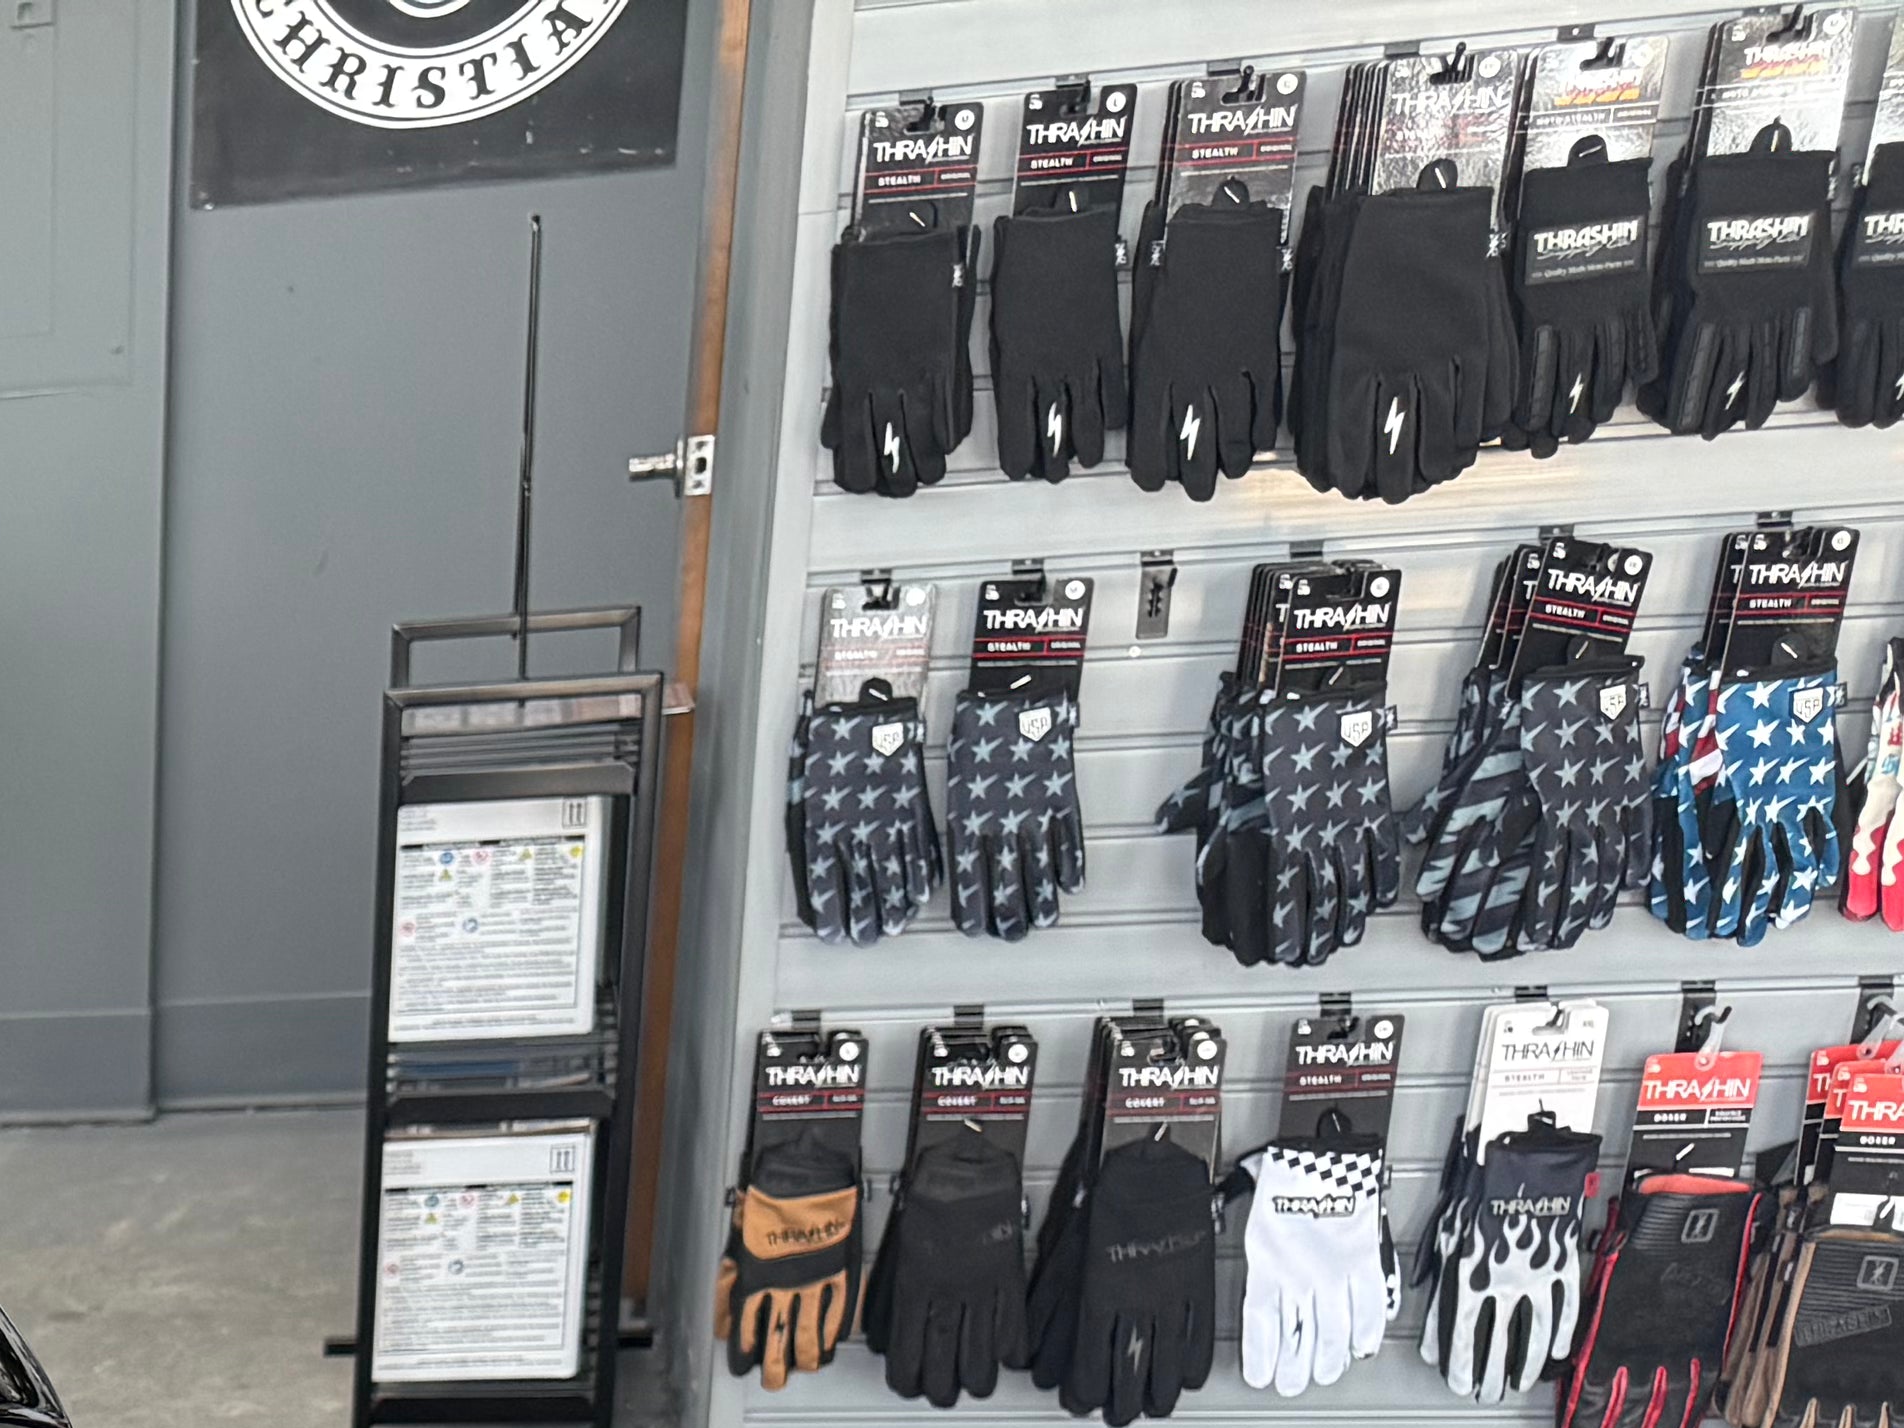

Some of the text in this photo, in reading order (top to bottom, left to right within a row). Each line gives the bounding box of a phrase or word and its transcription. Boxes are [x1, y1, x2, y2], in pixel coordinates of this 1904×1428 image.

[258, 0, 610, 110] HRISTIA
[1192, 147, 1239, 160] STEALTH
[1030, 157, 1074, 169] STEALTH
[878, 174, 922, 187] STEALTH
[1707, 215, 1809, 242] THRASHIN
[1534, 220, 1638, 254] THRASHIN
[1749, 599, 1792, 609] STEALTH
[1545, 604, 1586, 618] STEALTH
[988, 641, 1031, 653] STEALTH
[1296, 642, 1338, 653] STEALTH
[1299, 1074, 1342, 1086] STEALTH
